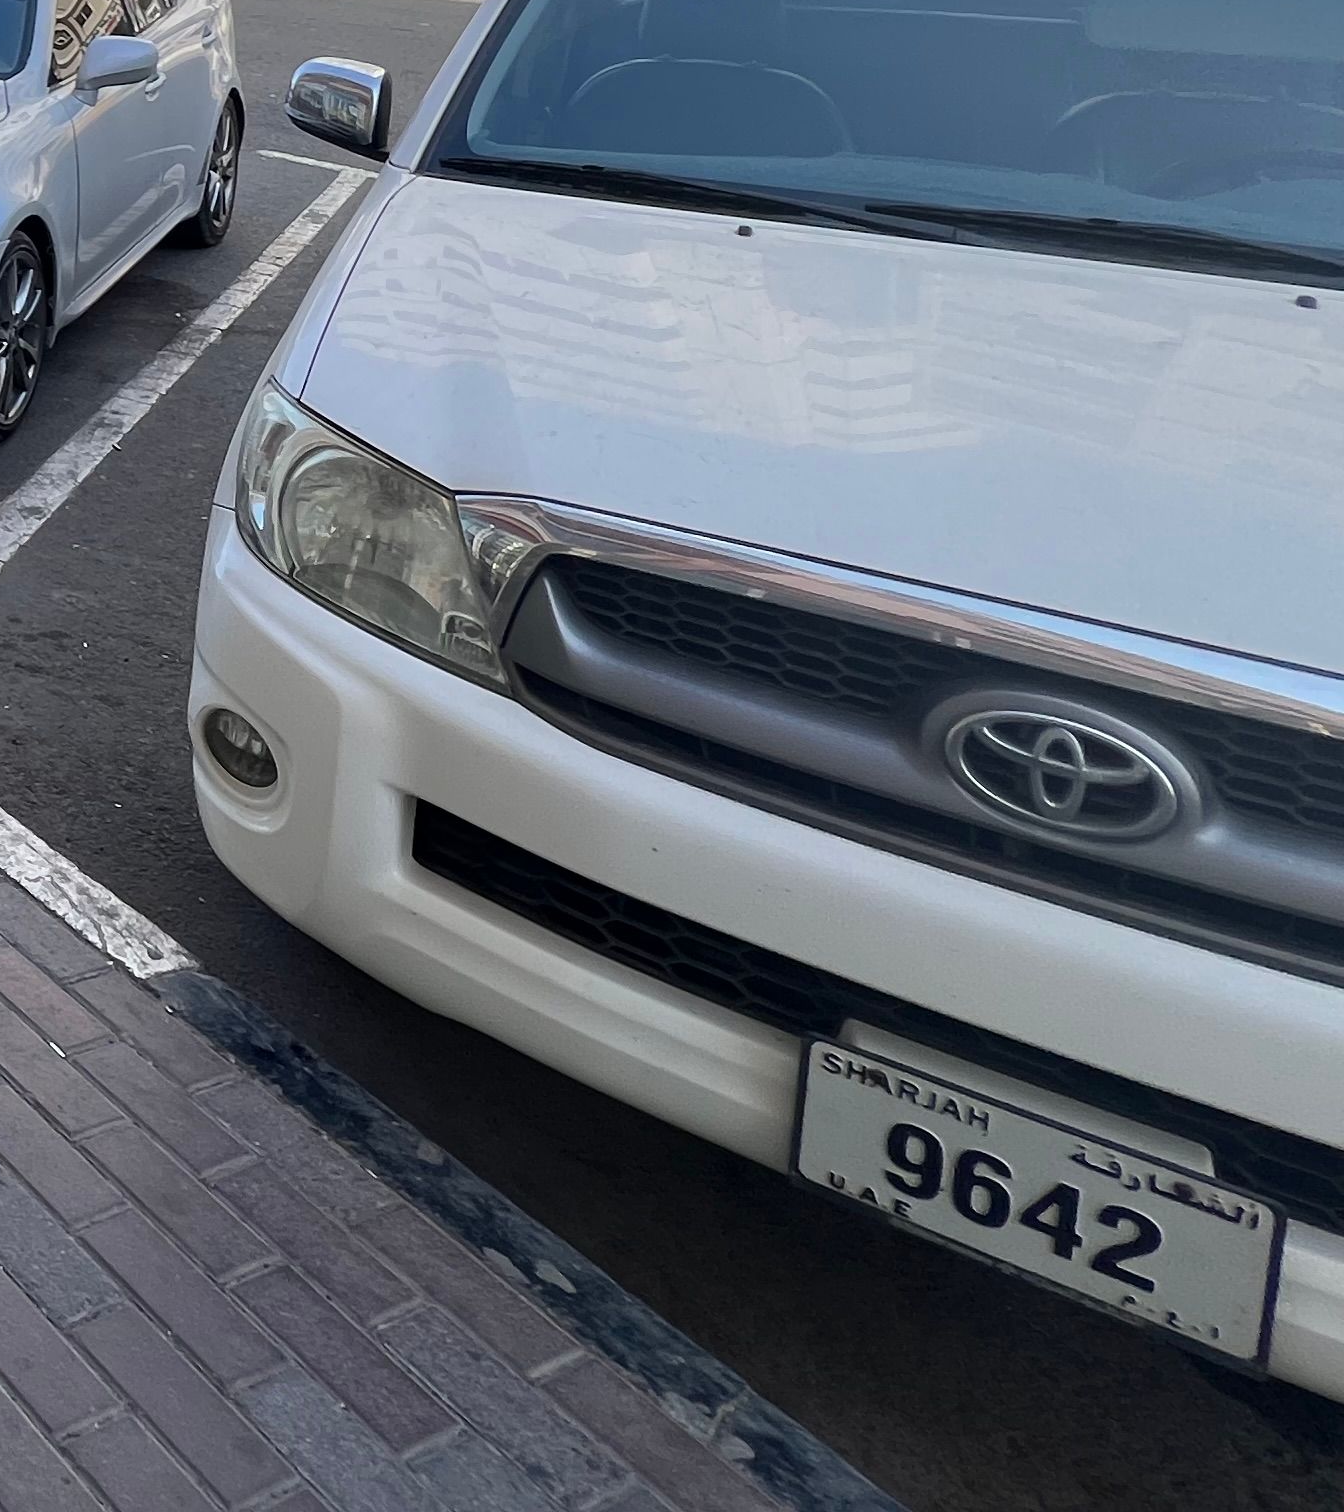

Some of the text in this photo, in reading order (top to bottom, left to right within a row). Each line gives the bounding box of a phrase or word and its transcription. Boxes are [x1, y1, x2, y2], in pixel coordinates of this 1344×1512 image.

[820, 1051, 991, 1136] SHARJAH
[883, 1122, 1164, 1293] 9642
[1068, 1143, 1261, 1230] الشارقة
